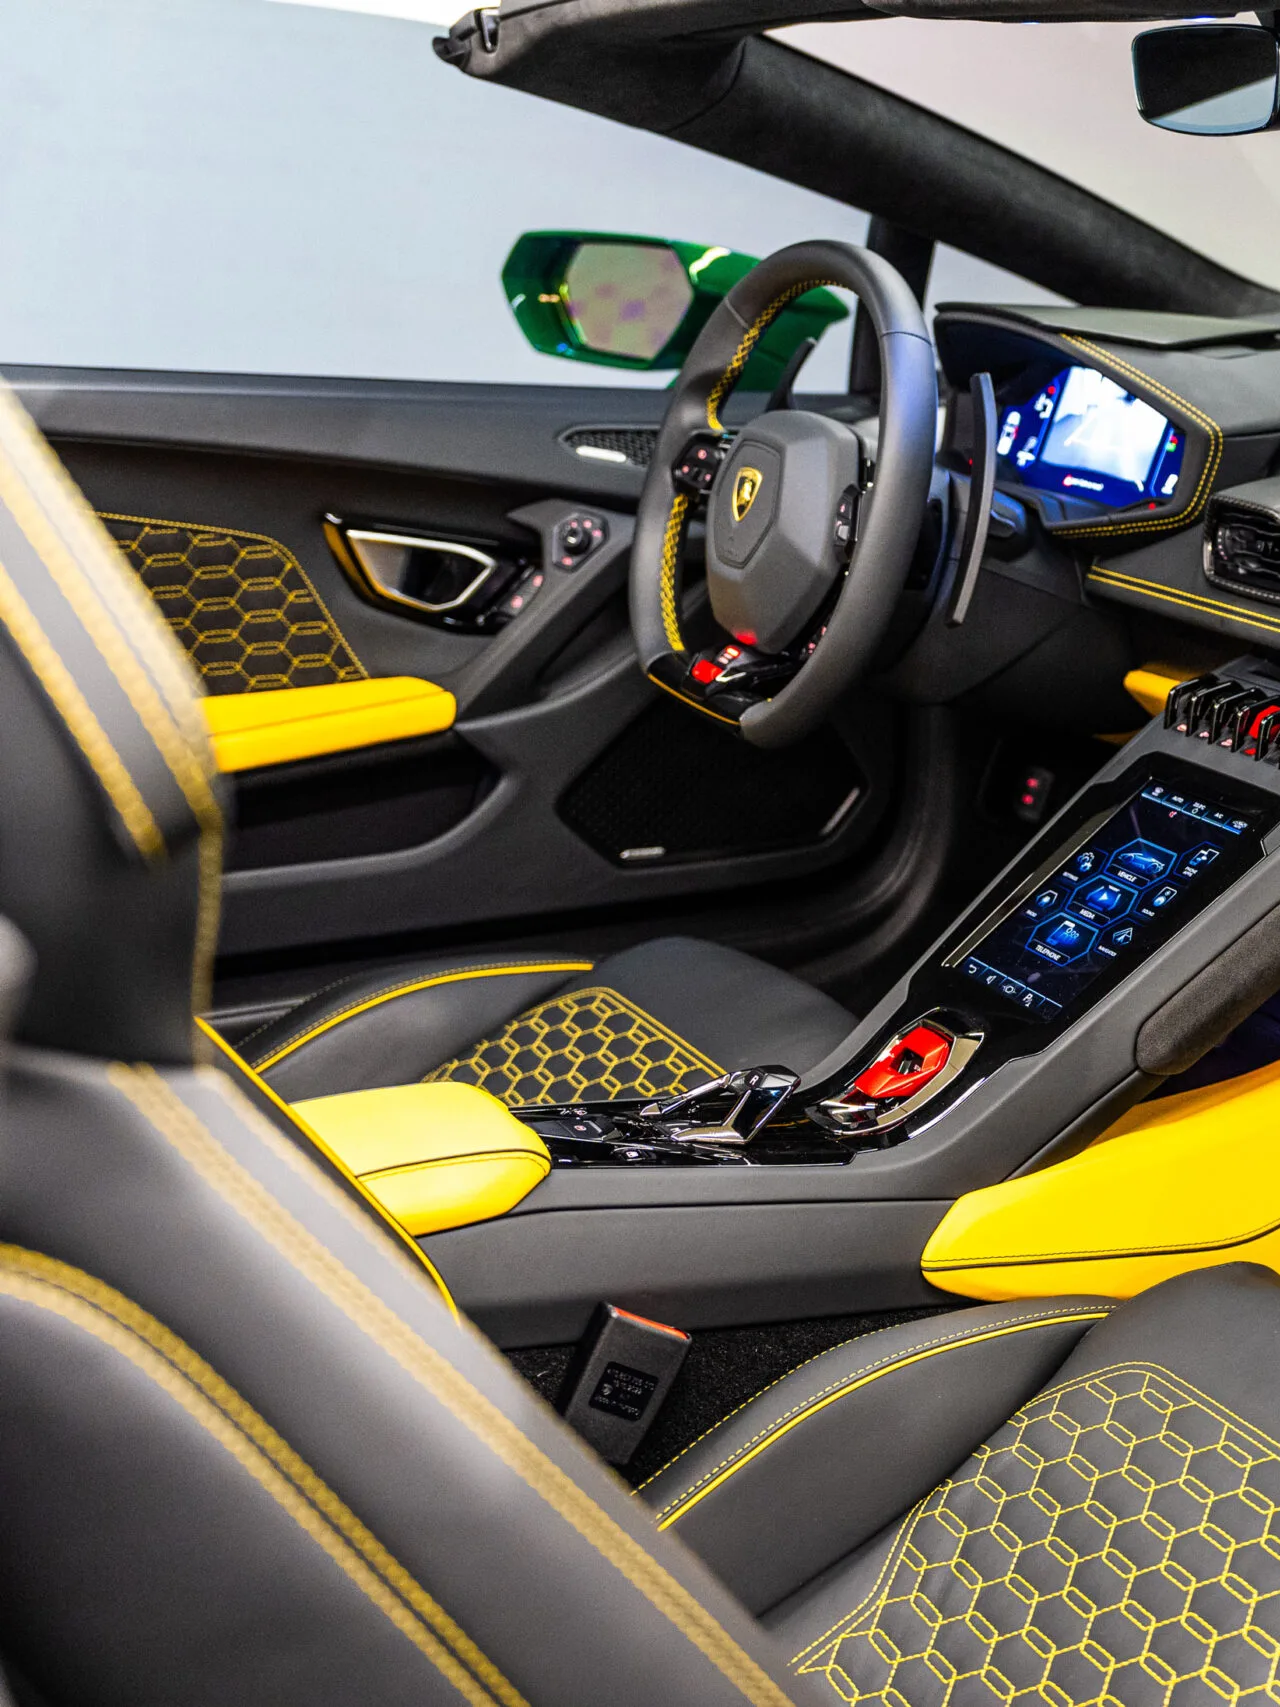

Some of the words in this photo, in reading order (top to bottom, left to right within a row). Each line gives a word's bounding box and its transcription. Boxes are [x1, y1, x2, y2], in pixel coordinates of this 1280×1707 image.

[1117, 870, 1137, 882] VEHICLE
[1035, 944, 1062, 961] TELEPHONE
[749, 1075, 759, 1086] R
